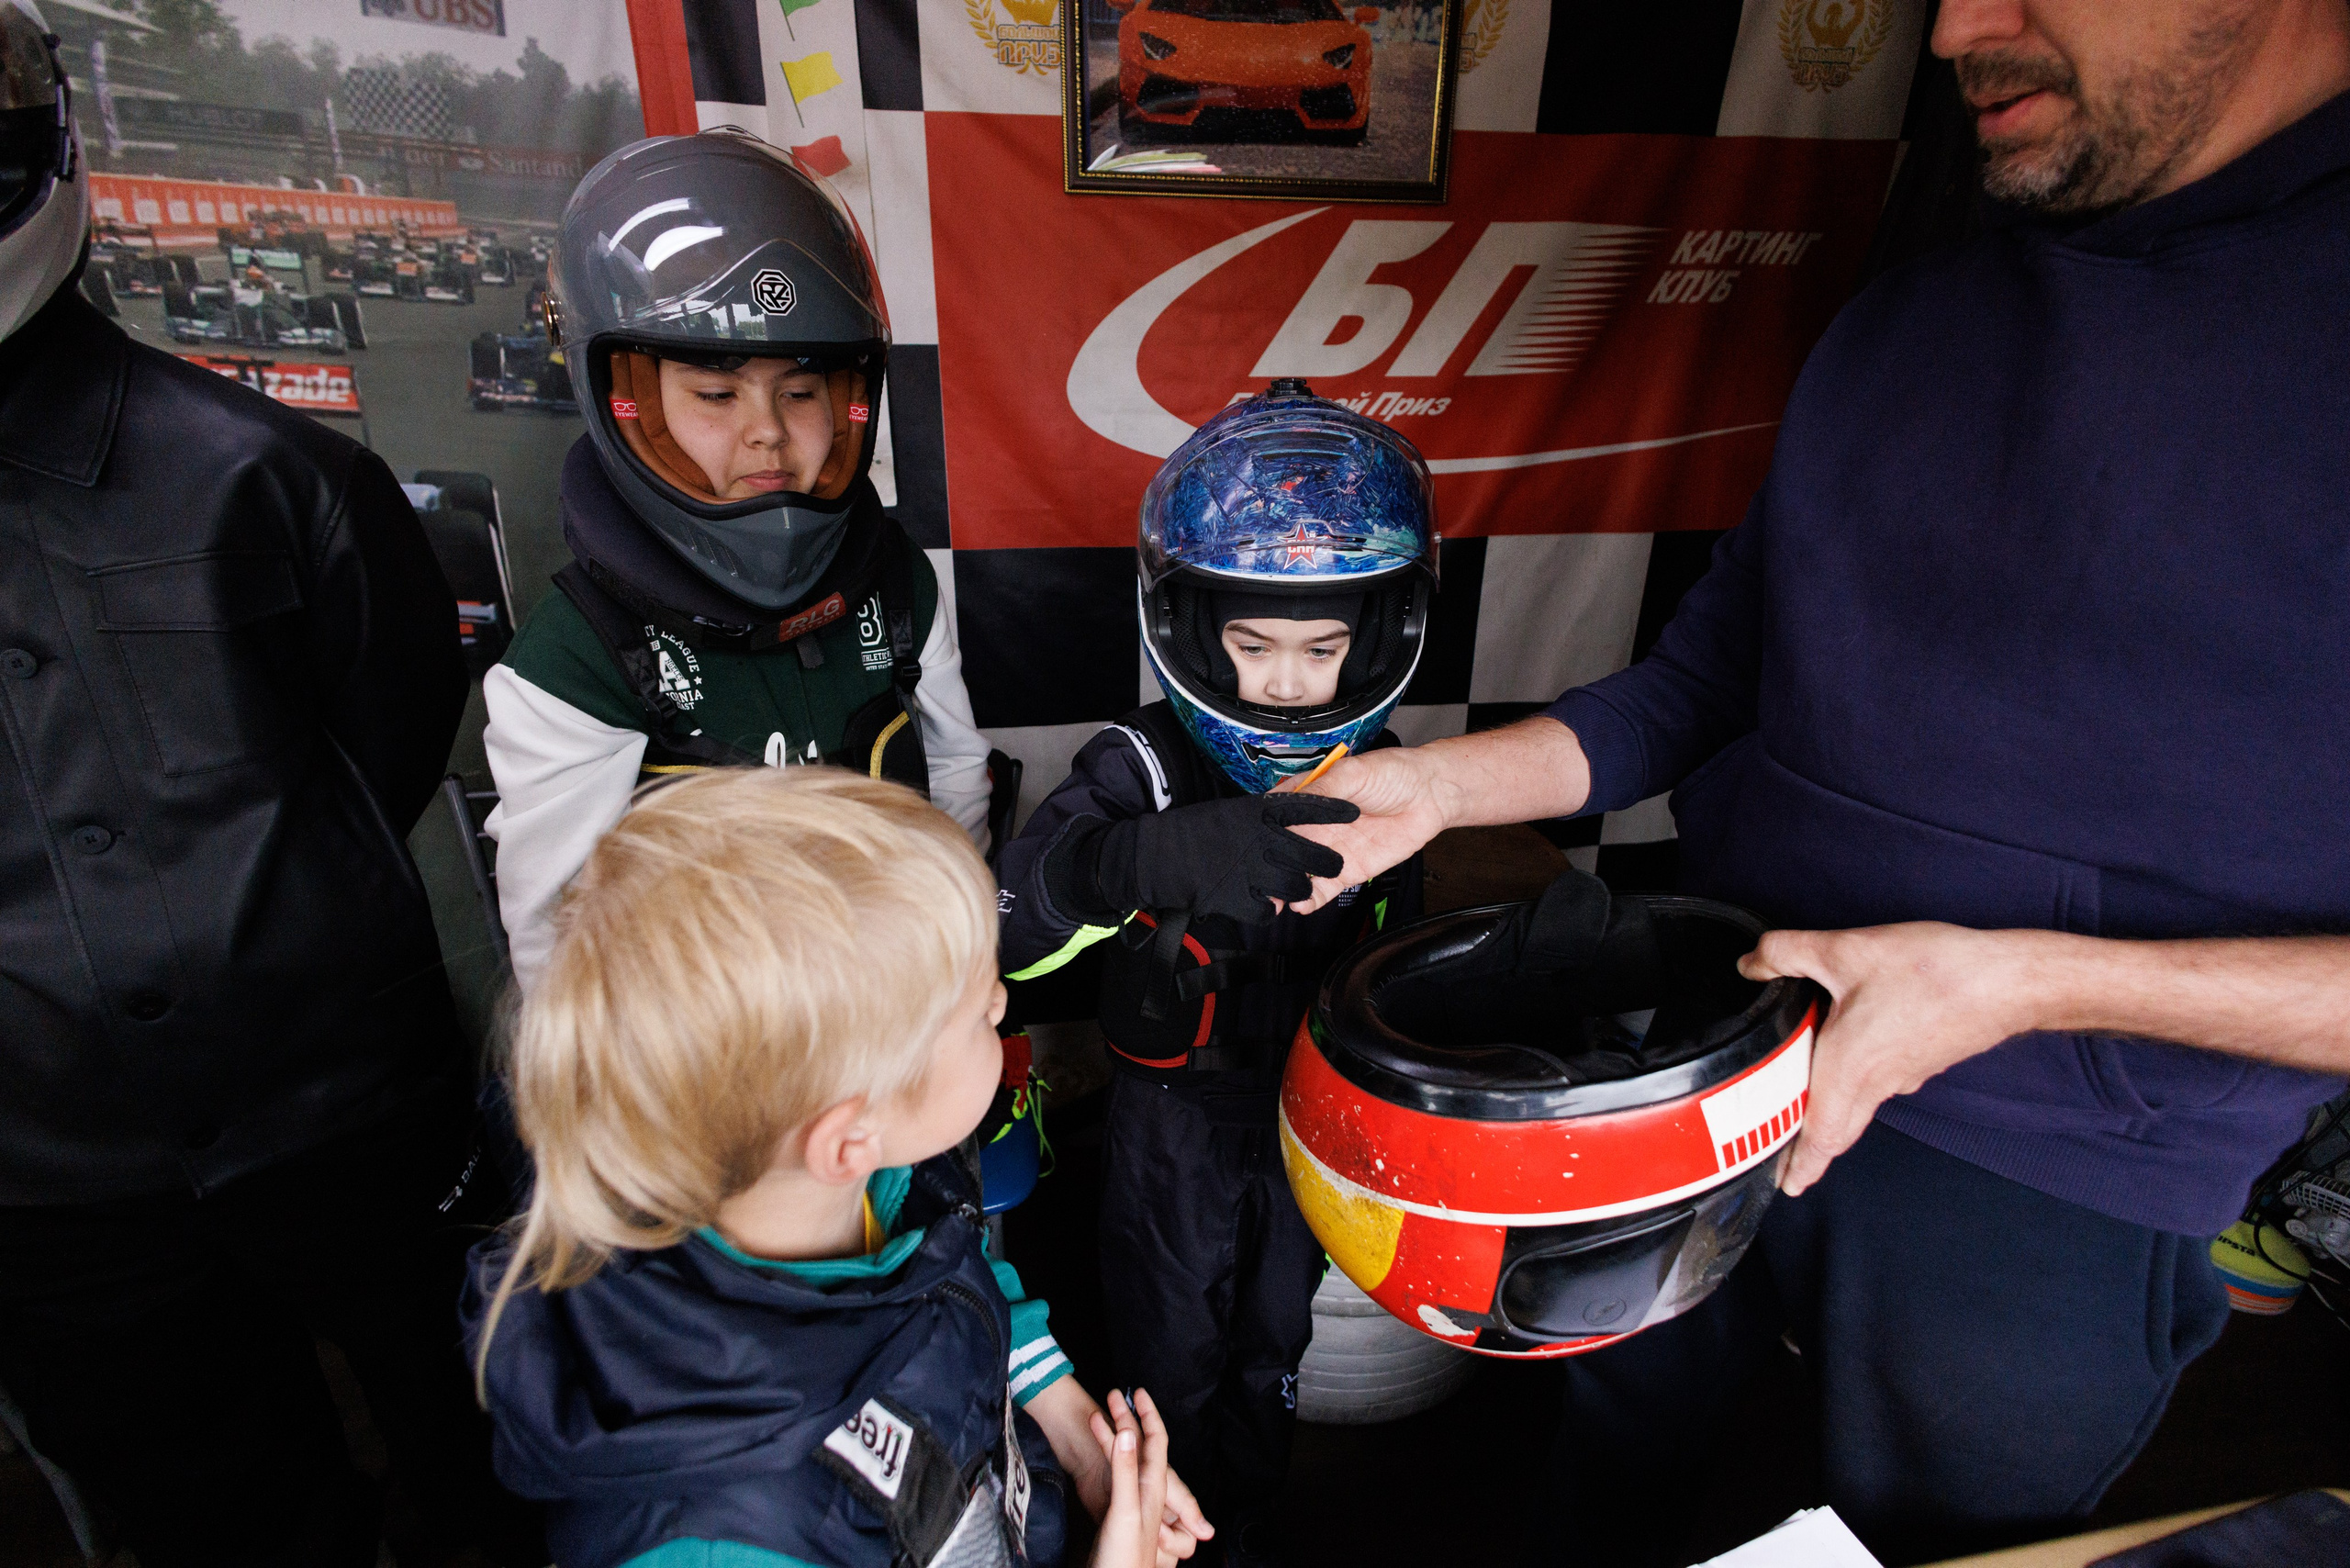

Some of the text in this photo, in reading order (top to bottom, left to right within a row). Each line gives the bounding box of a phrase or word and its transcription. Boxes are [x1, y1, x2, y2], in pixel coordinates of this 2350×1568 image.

[487, 150, 584, 178] Santand
[1669, 230, 1823, 264] КАРТИНГ
[1248, 219, 1666, 377] БП
[1646, 270, 1740, 304] КЛУБ
[1366, 391, 1452, 422] Приз
[786, 599, 840, 633] RLG
[661, 631, 699, 672] LEAGUE
[664, 658, 685, 683] NGELES
